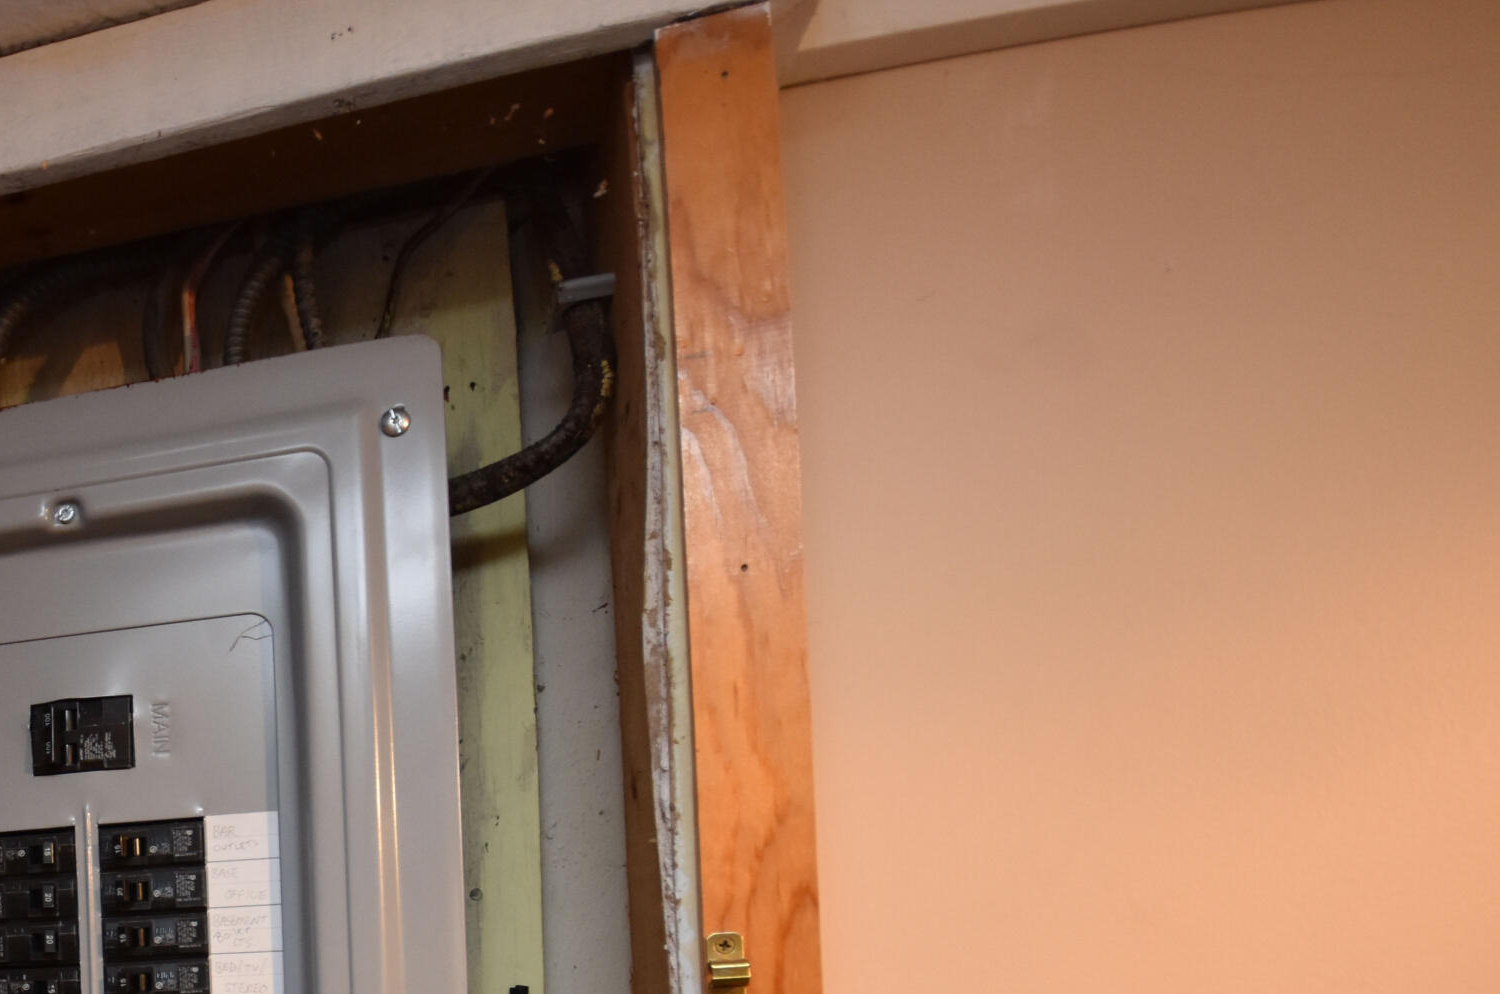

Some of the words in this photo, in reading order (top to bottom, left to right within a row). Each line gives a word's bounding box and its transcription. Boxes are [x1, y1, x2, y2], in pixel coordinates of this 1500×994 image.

[148, 701, 172, 758] MAIN
[43, 892, 53, 903] 20
[45, 934, 55, 945] 20
